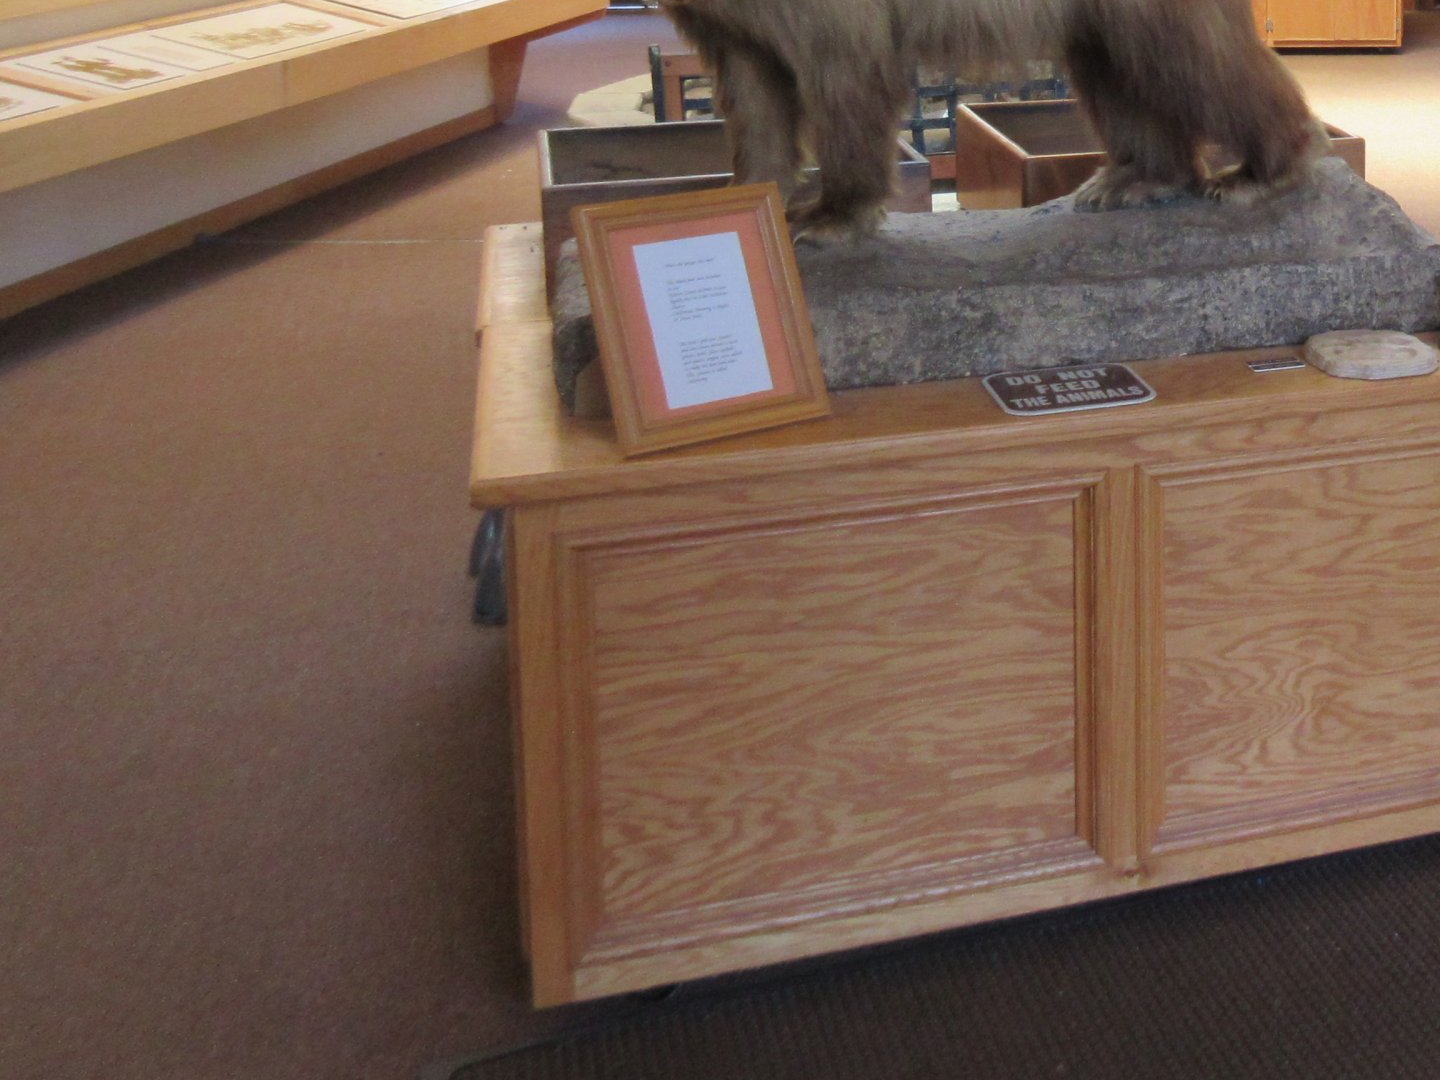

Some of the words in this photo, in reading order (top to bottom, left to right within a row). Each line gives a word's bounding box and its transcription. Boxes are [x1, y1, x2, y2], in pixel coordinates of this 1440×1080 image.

[1006, 374, 1041, 386] DO
[1057, 368, 1108, 382] NOT
[1035, 379, 1101, 394] FEED
[1009, 396, 1051, 409] THE
[1056, 387, 1143, 404] ANIMALS
